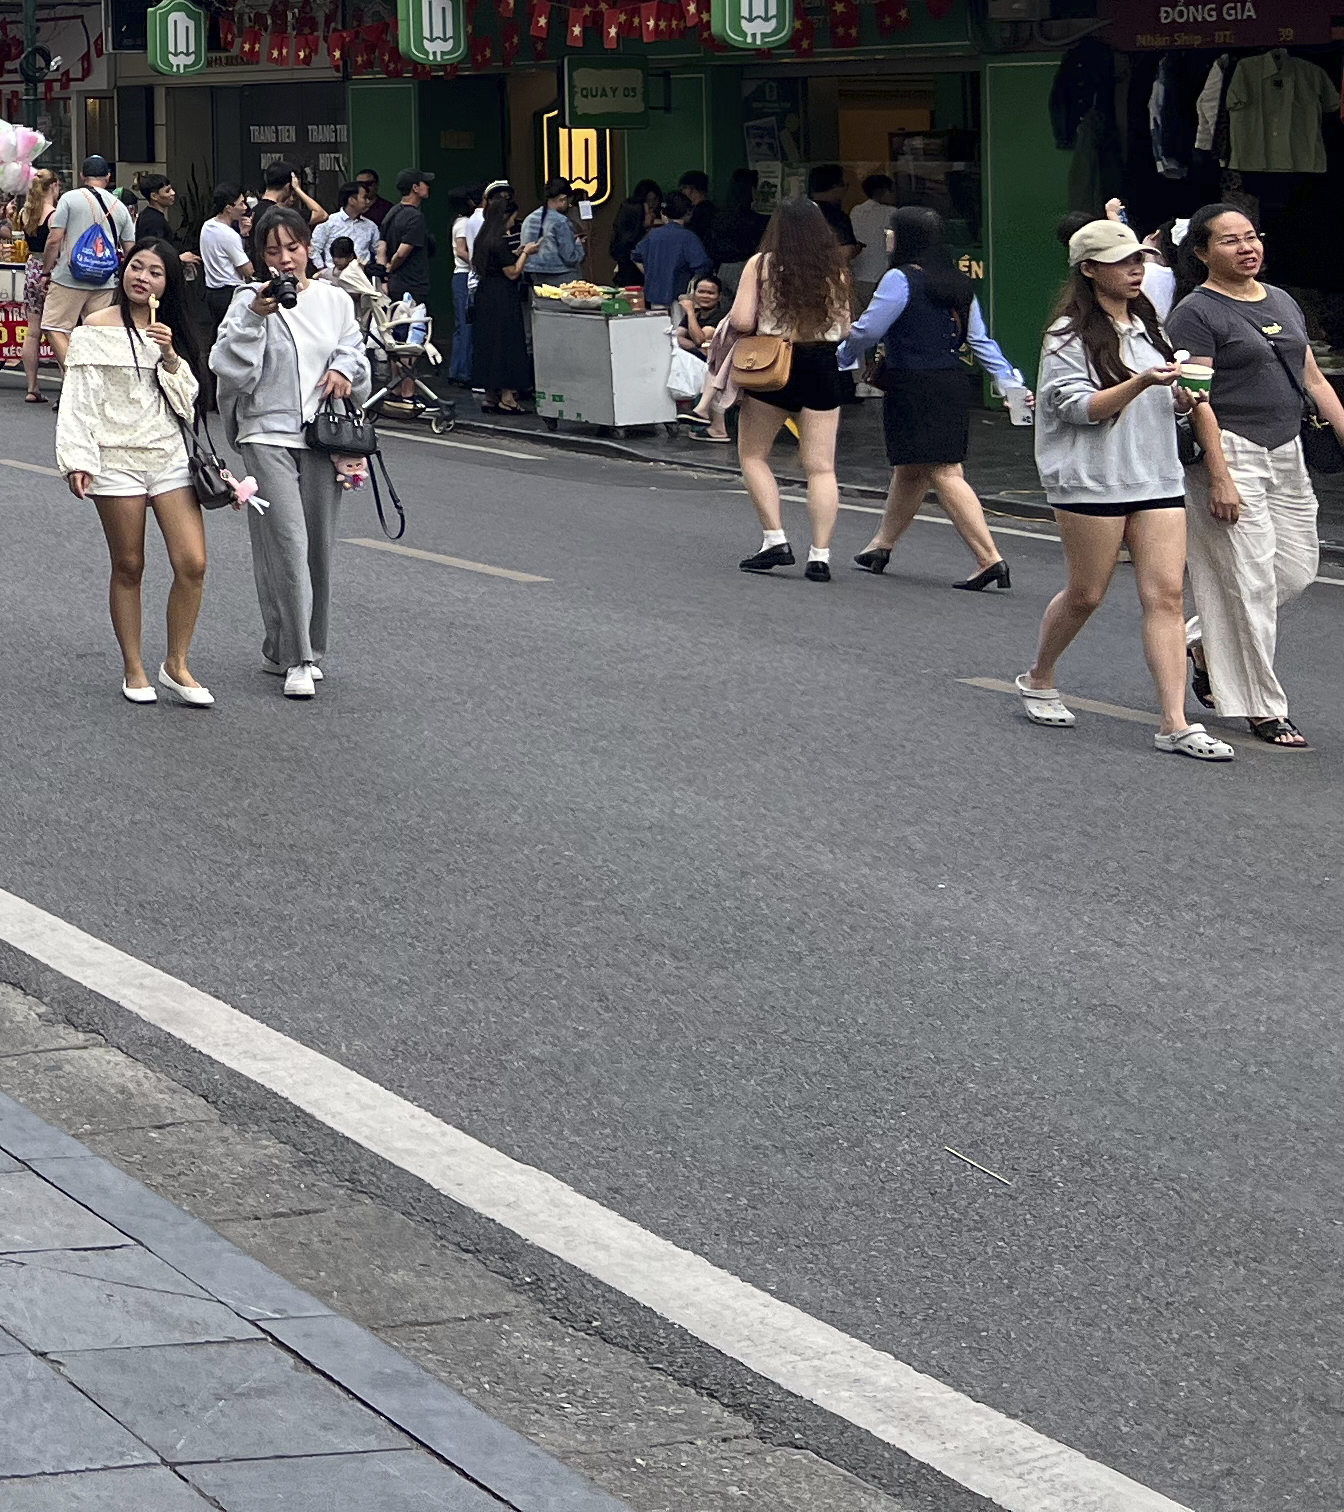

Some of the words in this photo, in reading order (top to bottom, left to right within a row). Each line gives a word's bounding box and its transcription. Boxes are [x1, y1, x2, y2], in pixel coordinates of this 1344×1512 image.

[623, 86, 637, 99] 05
[249, 125, 277, 143] TRANG
[277, 125, 296, 143] TIEN
[307, 124, 336, 143] TRANG
